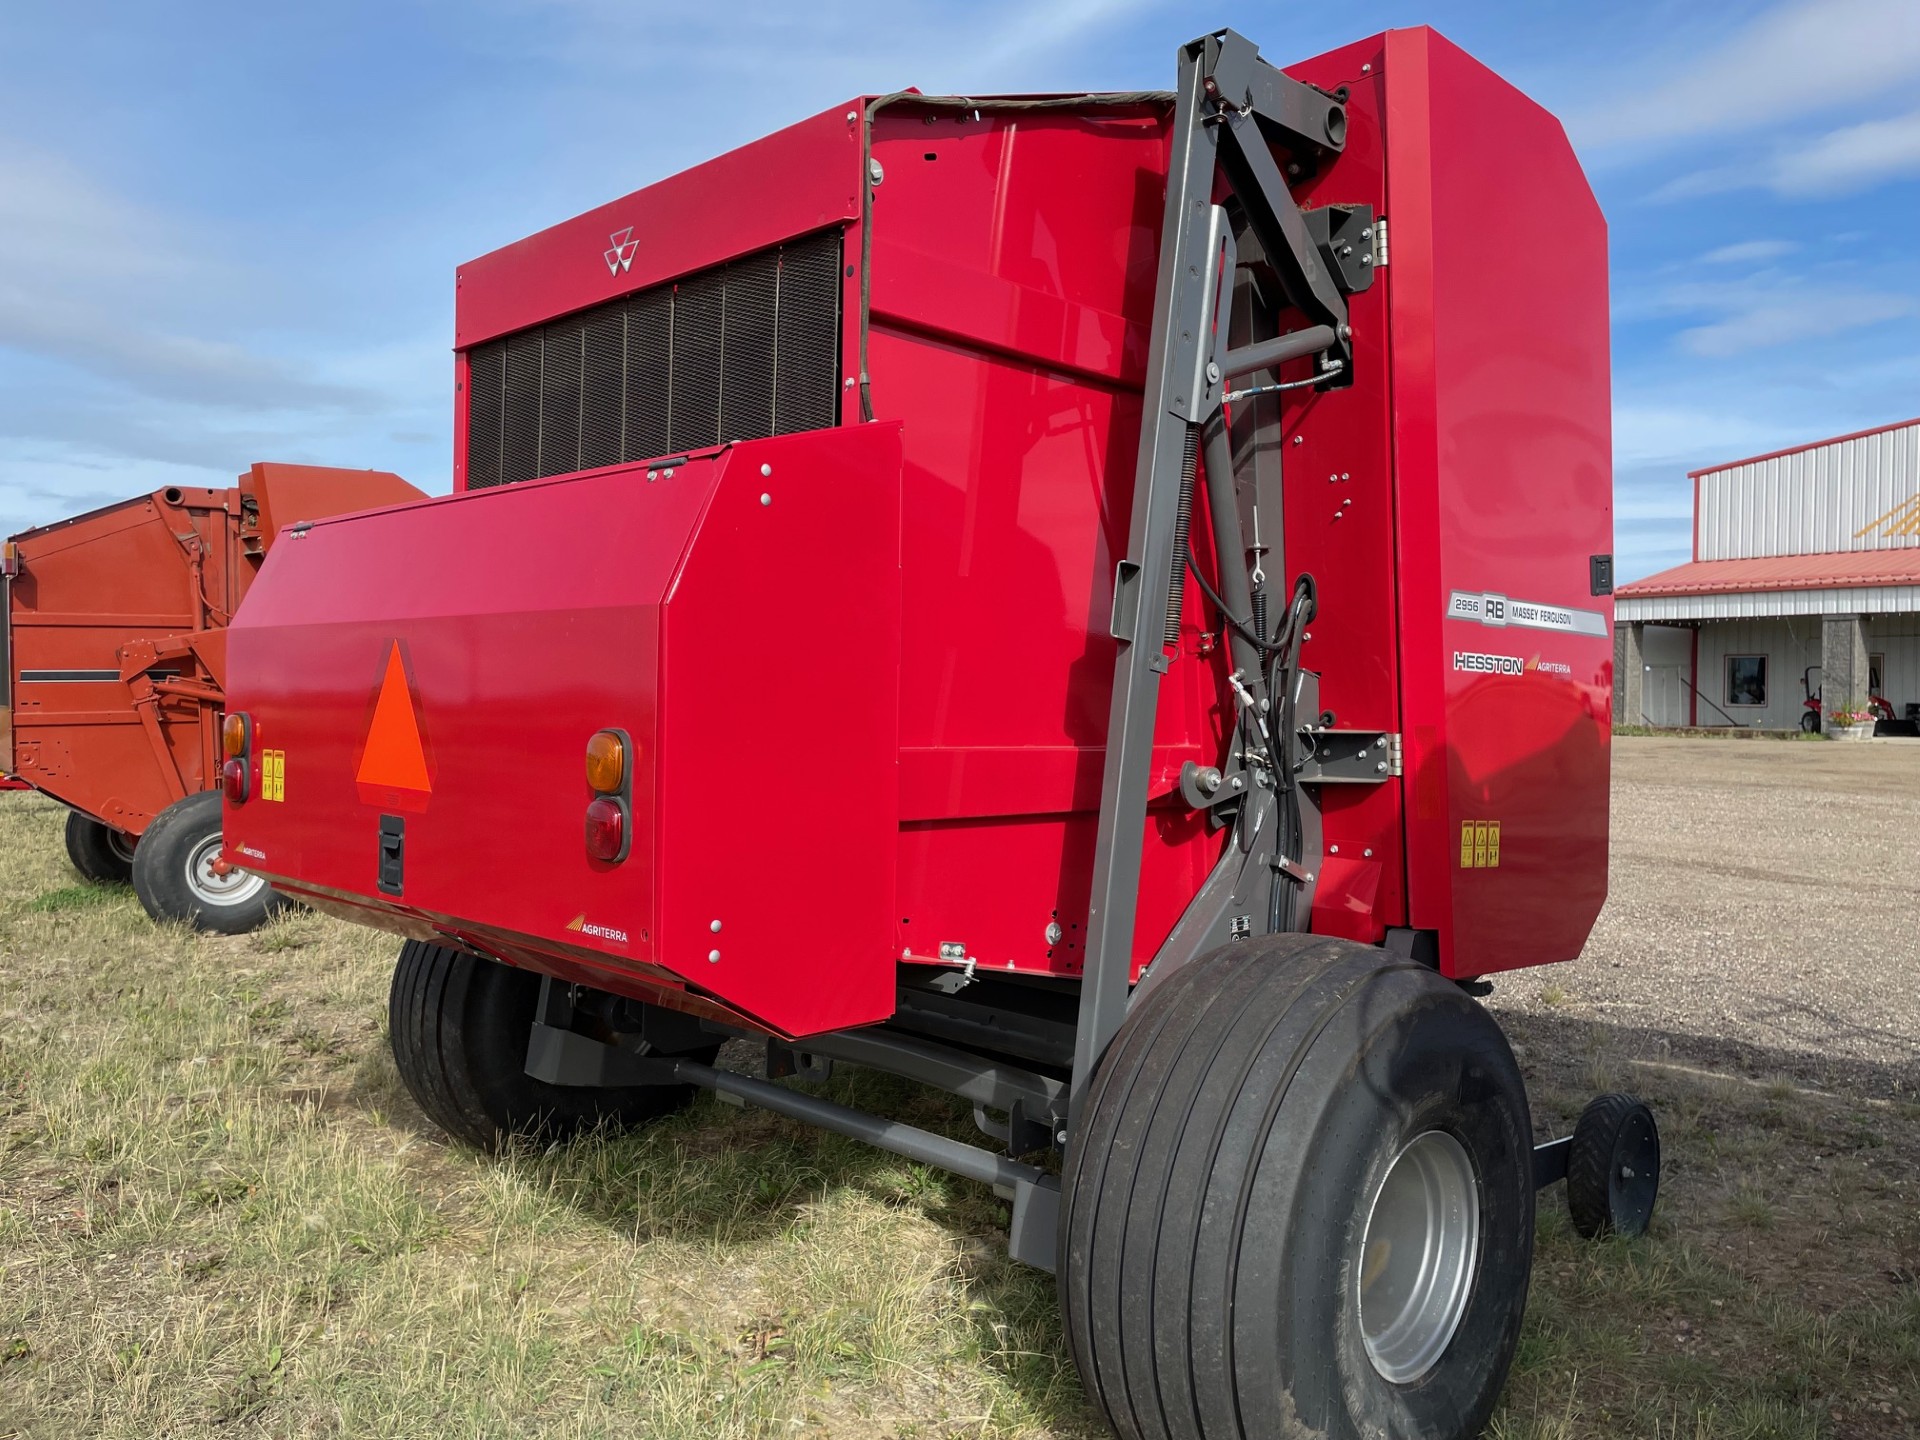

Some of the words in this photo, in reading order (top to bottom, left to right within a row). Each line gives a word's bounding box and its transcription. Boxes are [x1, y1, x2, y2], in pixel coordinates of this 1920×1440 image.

[1455, 599, 1479, 612] 2956
[1485, 599, 1504, 619] RB
[1512, 606, 1538, 621] MASSEY
[1540, 610, 1572, 625] FERGUSON
[1454, 652, 1523, 674] HESSTON
[1537, 662, 1571, 674] AGRITERRA
[582, 923, 628, 942] AGRITERRA
